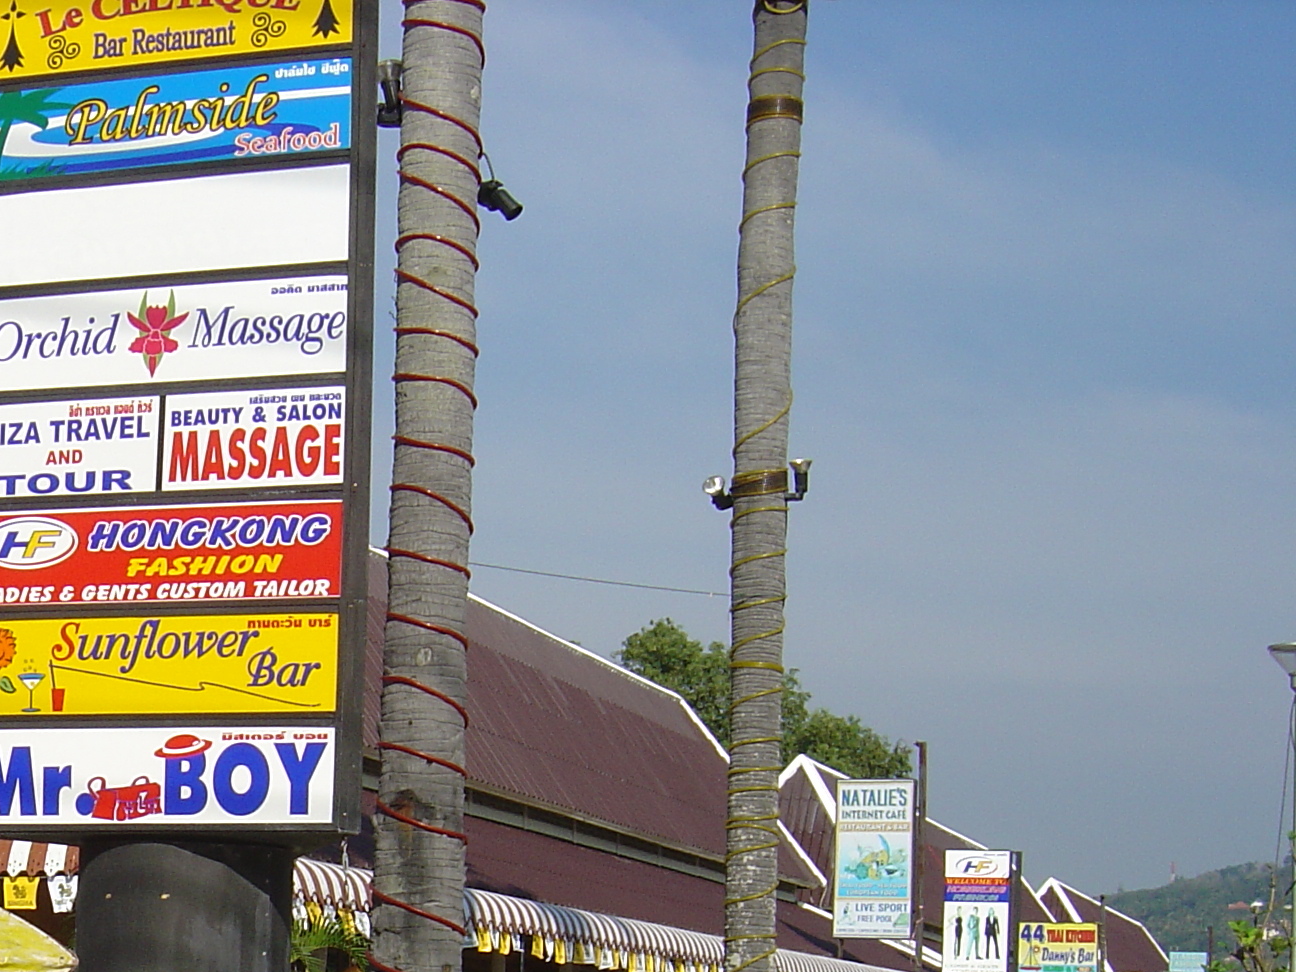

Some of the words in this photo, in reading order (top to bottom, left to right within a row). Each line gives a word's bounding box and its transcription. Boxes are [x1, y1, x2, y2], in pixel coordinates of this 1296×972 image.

[35, 8, 84, 39] Le
[93, 32, 127, 59] Bar
[131, 20, 236, 56] Restaurant
[64, 74, 281, 147] Palmside
[234, 122, 341, 157] Seafood
[188, 306, 347, 355] Massage
[171, 405, 243, 428] BEAUTY
[251, 405, 267, 423] &
[276, 402, 342, 422] SALON
[50, 415, 150, 443] TRAVEL
[45, 449, 83, 466] AND
[168, 424, 341, 484] MASSAGE
[89, 515, 331, 550] HONGKONG
[126, 554, 284, 577] FASHION
[59, 585, 74, 601] &
[81, 583, 149, 601] GENTS
[156, 581, 245, 599] CUSTOM
[253, 579, 330, 597] TAILOR
[51, 619, 260, 674] Sunflower
[247, 647, 321, 689] Bar
[163, 742, 328, 817] BOY
[841, 787, 907, 807] NATALIE'S
[841, 810, 885, 820] INTERNET
[963, 861, 992, 873] HF
[855, 903, 875, 912] LIVE
[878, 903, 907, 912] SPORT
[857, 914, 874, 922] FREE
[1020, 924, 1044, 943] 44
[1047, 929, 1064, 943] THAI
[1042, 947, 1075, 964] Danny's
[1078, 948, 1094, 963] Bar
